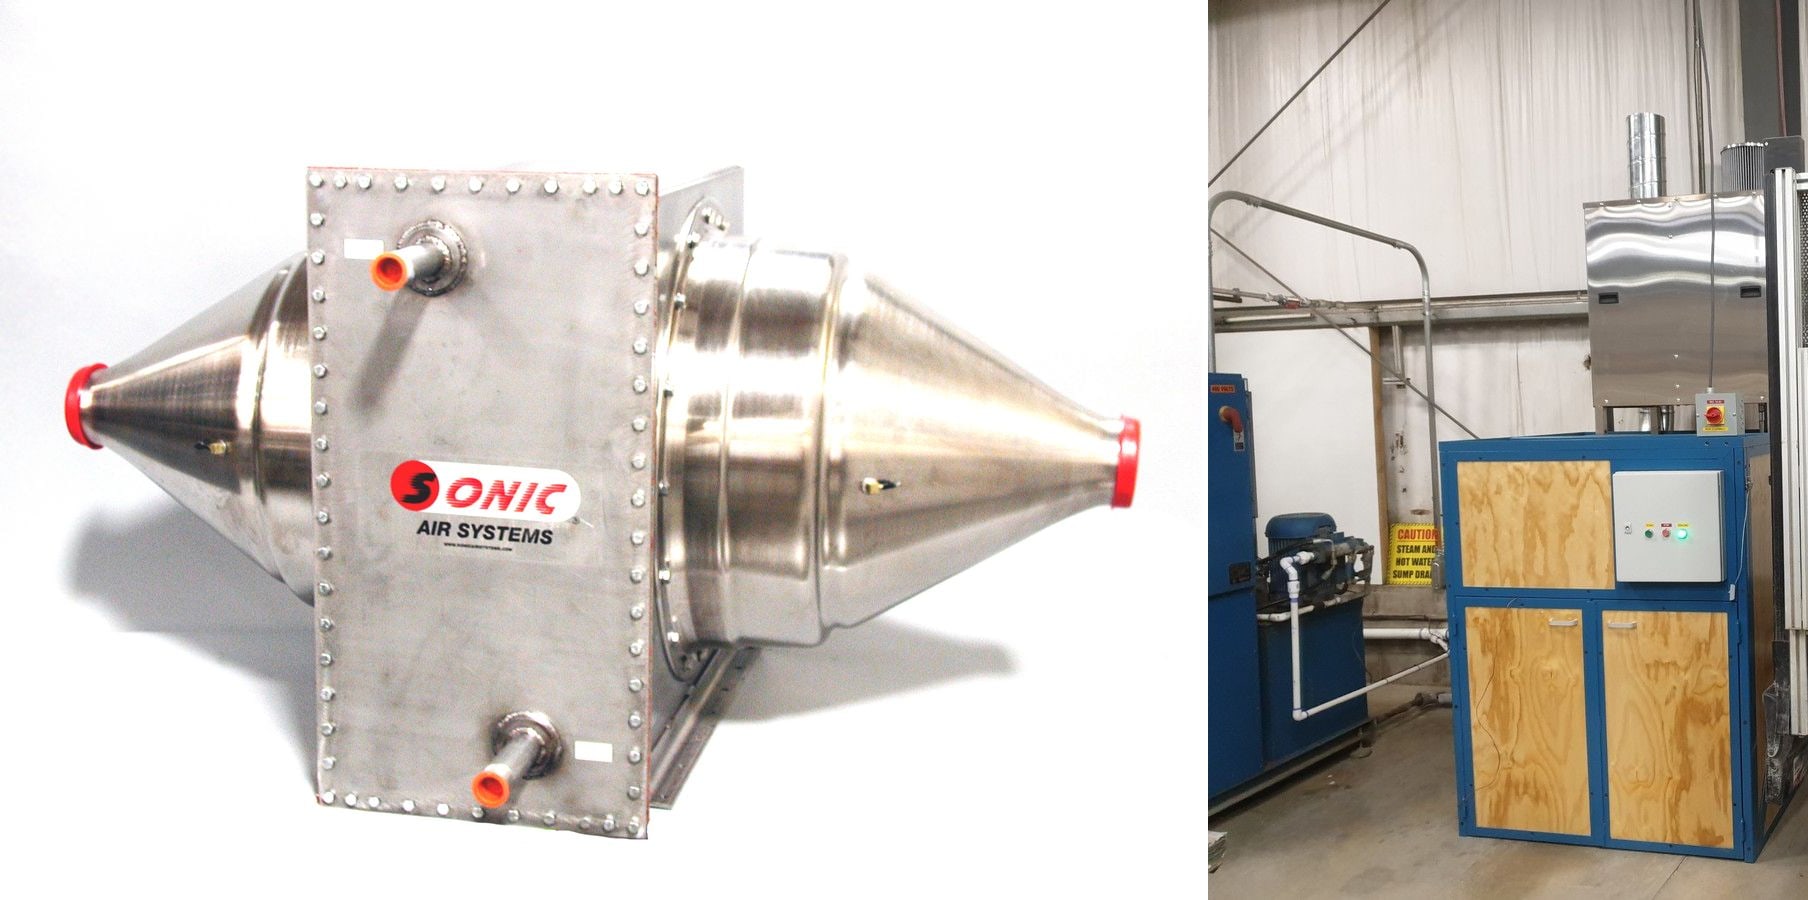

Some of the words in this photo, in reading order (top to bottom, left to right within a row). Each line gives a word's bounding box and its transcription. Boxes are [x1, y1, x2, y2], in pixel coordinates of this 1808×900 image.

[402, 472, 567, 515] SONIC
[417, 520, 451, 536] AIR
[457, 523, 553, 545] SYSTEMS
[1396, 545, 1420, 553] STEAM
[1396, 558, 1410, 566] HOT
[1412, 558, 1434, 566] WATE
[1393, 570, 1414, 578] SUMP
